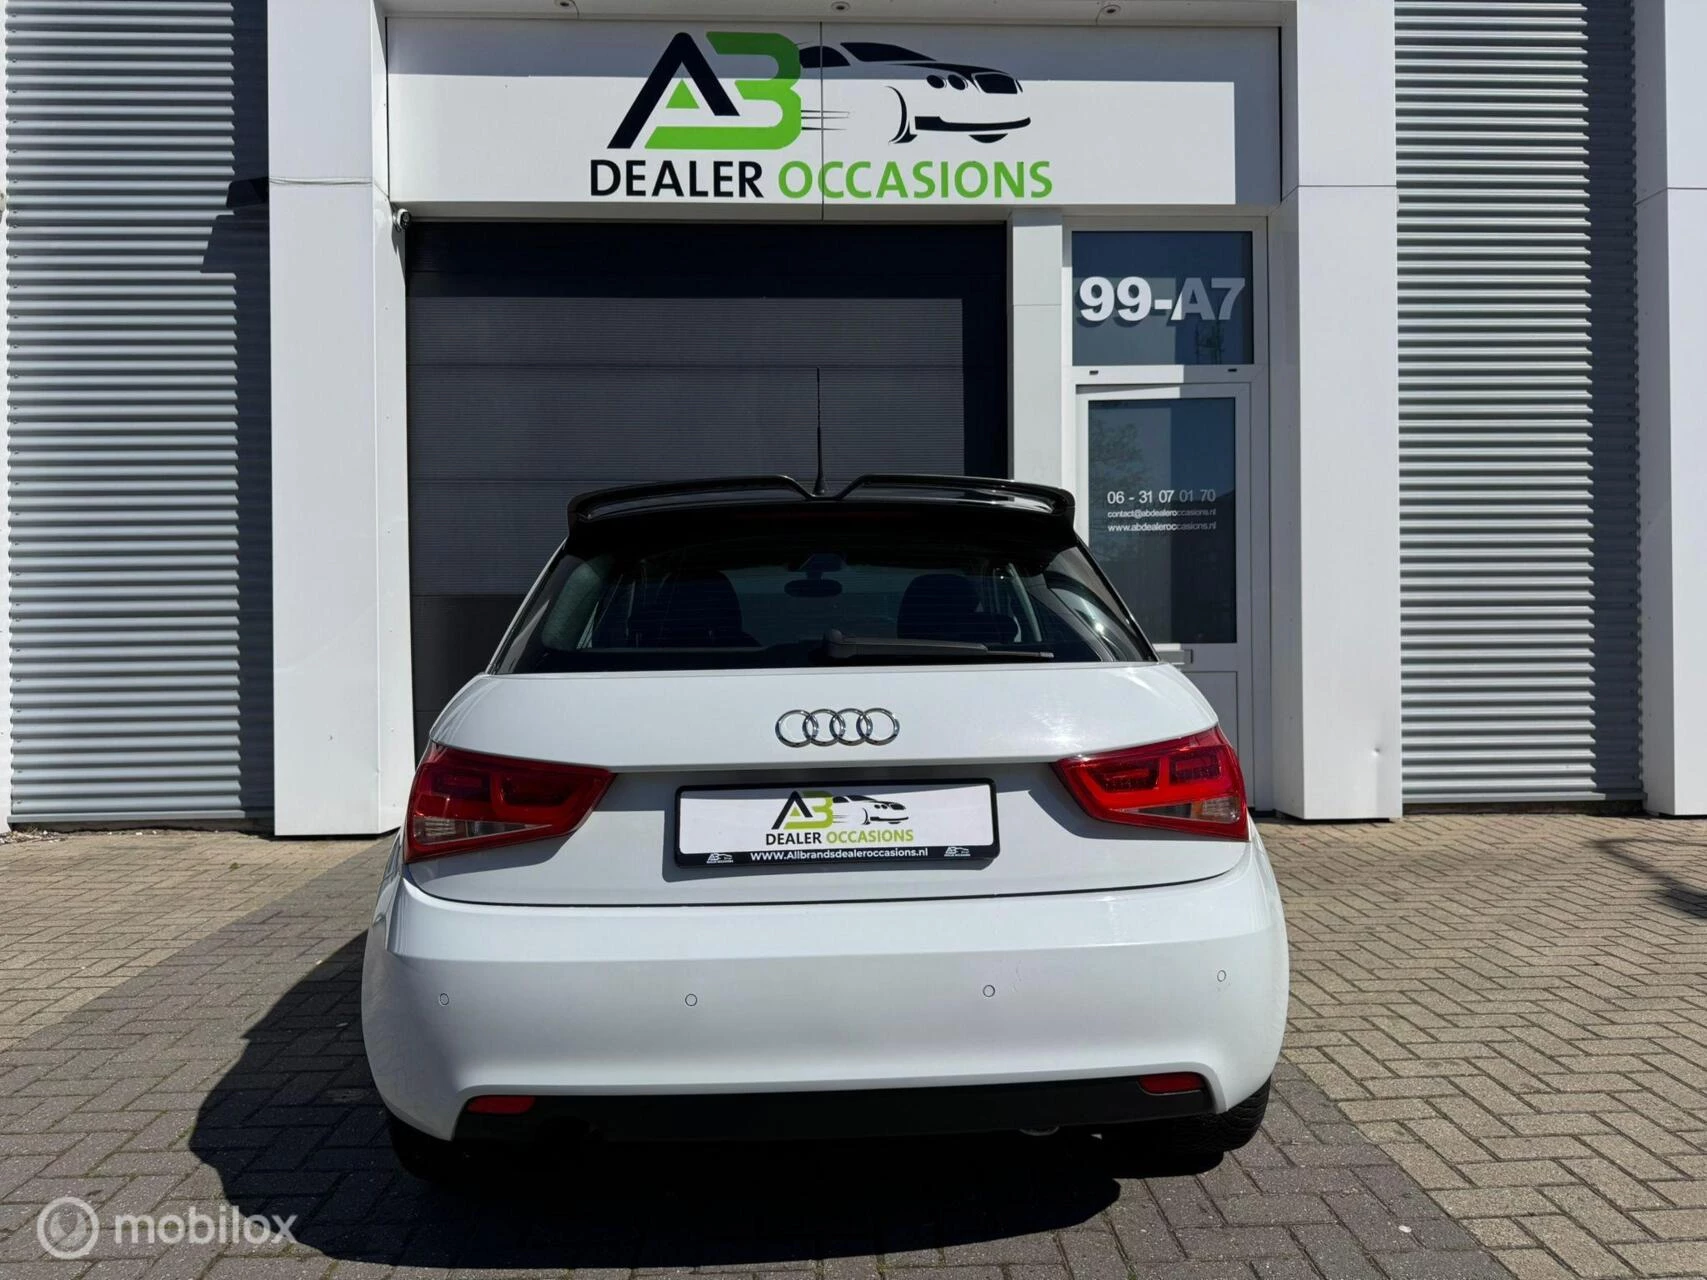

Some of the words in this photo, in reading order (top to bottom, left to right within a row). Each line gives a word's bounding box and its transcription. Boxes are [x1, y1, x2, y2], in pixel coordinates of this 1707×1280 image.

[590, 160, 763, 198] DEALER
[777, 160, 1053, 198] OCCASIONS
[1079, 276, 1246, 322] 99-A7
[1106, 491, 1125, 504] 06
[1138, 490, 1153, 503] 31
[1158, 489, 1175, 503] 07
[1179, 489, 1194, 502] 01
[1200, 489, 1216, 502] 70
[1107, 508, 1217, 519] contact@abdealeroccasions.nl
[1107, 521, 1217, 532] www.abdealeroccasions.nl
[765, 832, 822, 846] DEALER
[826, 829, 914, 844] OCCASIONS
